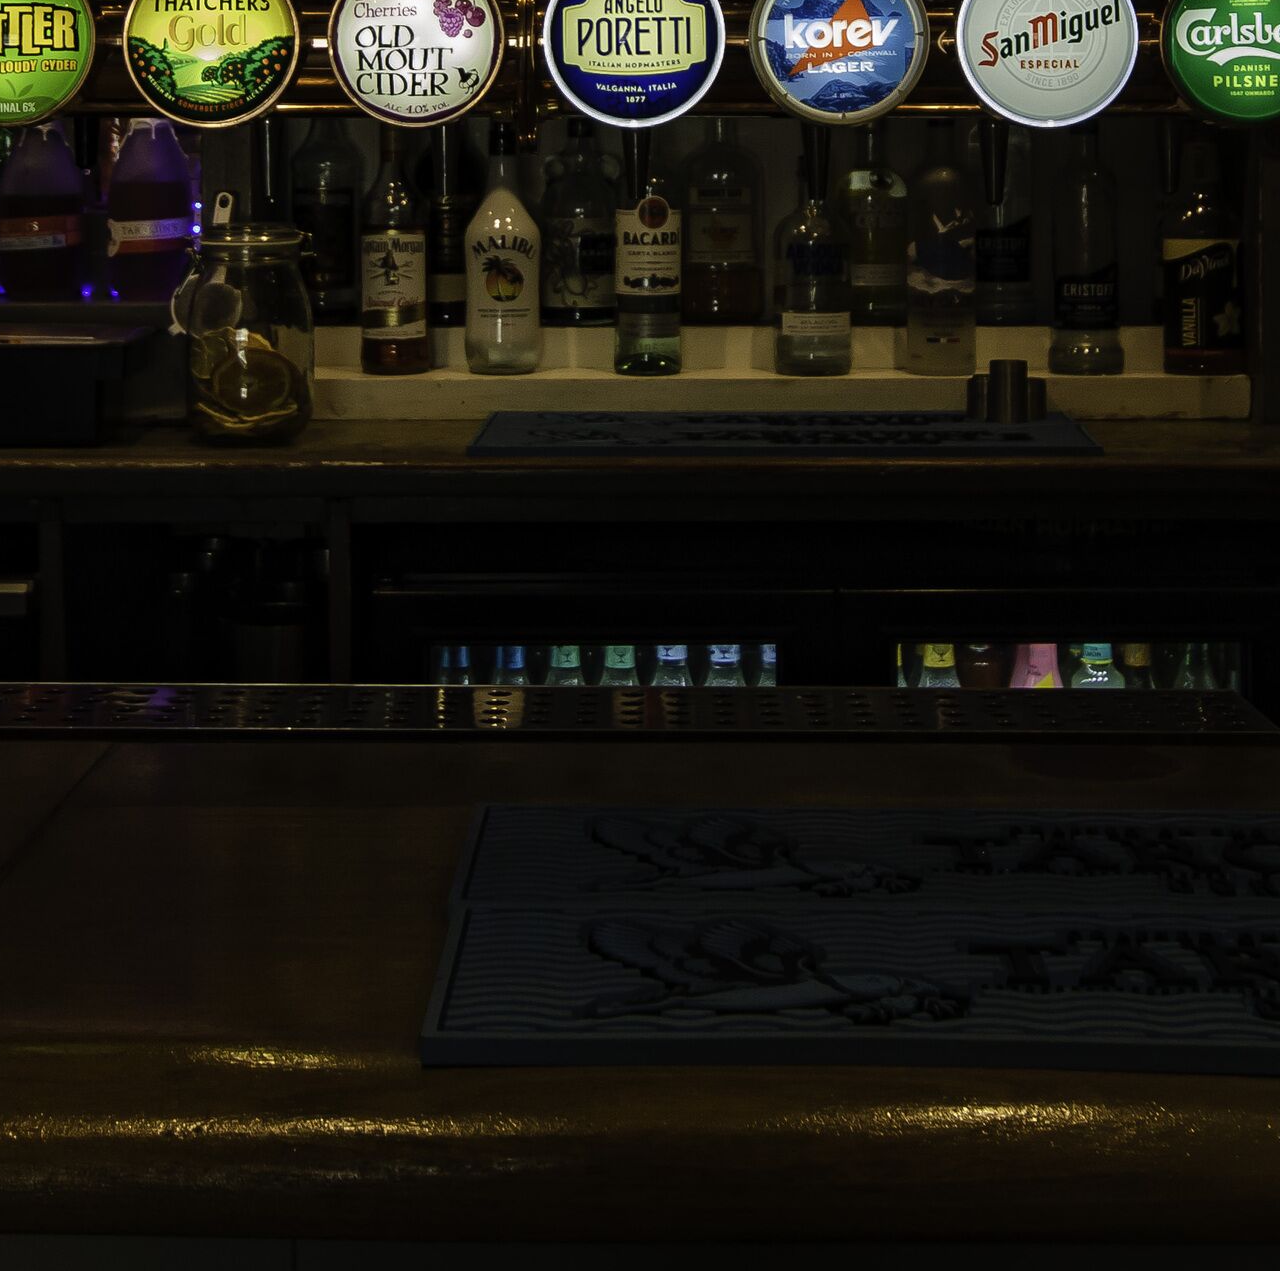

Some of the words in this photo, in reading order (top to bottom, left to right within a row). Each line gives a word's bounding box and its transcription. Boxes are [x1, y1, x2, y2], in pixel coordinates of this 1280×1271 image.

[354, 2, 418, 18] Cherries
[168, 13, 249, 52] Gold
[355, 24, 415, 48] OLD
[577, 16, 692, 57] PORETTI
[784, 13, 899, 49] korev
[355, 47, 454, 71] MOUT
[786, 51, 817, 59] BORN
[40, 59, 78, 72] CYDER
[588, 60, 622, 68] ITALIAN
[625, 59, 681, 69] HOPMASTERS
[807, 61, 875, 74] LAGER
[1020, 59, 1080, 69] ESPECIAL
[1233, 64, 1271, 72] DANISH
[356, 72, 451, 97] CIDER
[648, 82, 677, 92] ITALIA
[1026, 73, 1053, 88] SINCE
[625, 95, 646, 103] 1877
[22, 102, 36, 113] 6%
[471, 235, 536, 261] MALIBU
[1181, 297, 1199, 347] VANILLA
